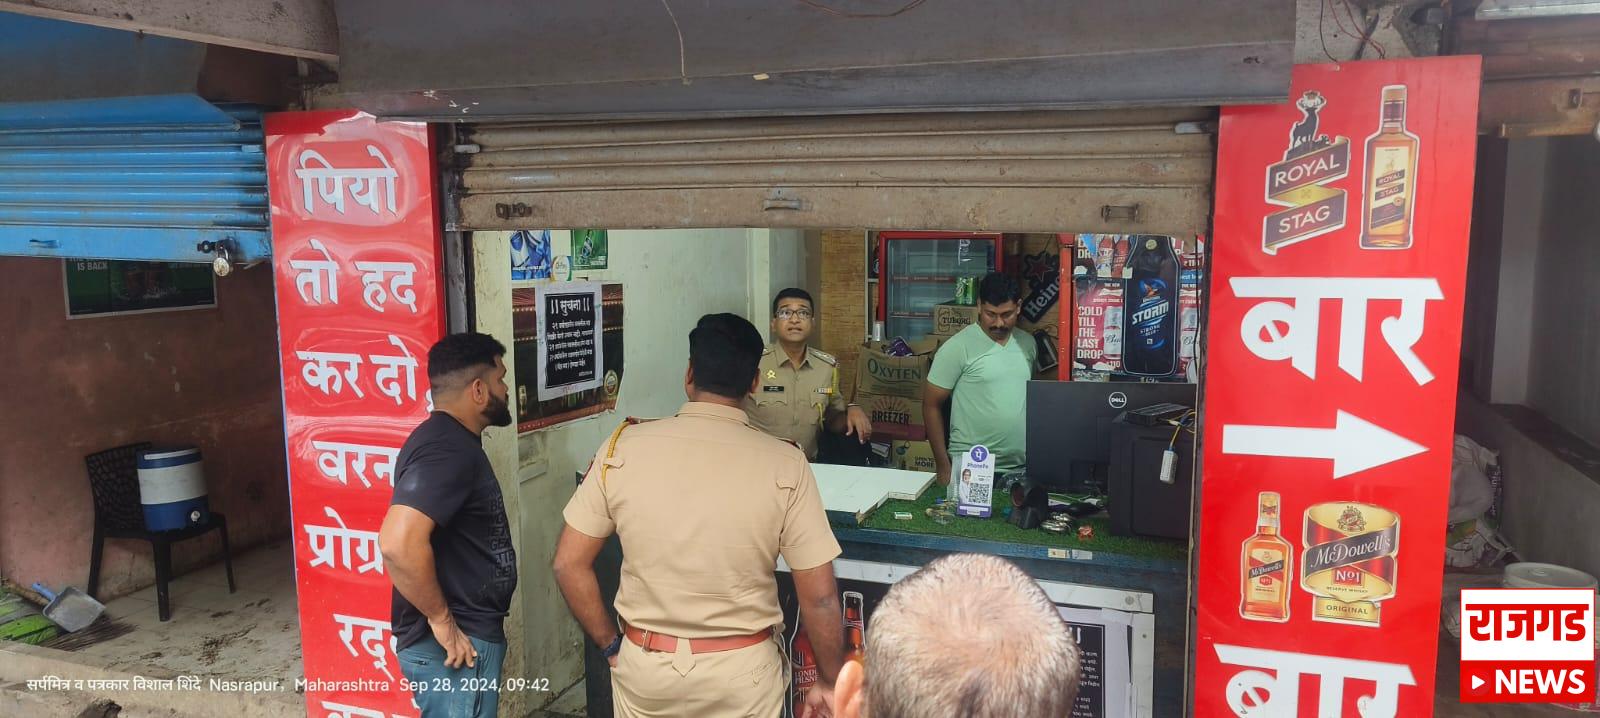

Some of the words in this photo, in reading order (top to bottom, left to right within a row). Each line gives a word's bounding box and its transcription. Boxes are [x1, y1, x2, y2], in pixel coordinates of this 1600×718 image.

[295, 144, 399, 216] पियो
[1274, 154, 1340, 188] ROYAL
[1278, 205, 1331, 235] STAG
[77, 262, 85, 271] IS
[289, 239, 338, 305] तो
[354, 261, 417, 314] हद
[1078, 305, 1103, 317] COLD
[1131, 301, 1169, 325] STORM
[1078, 316, 1097, 327] TILL
[1078, 327, 1096, 338] THE
[1228, 276, 1445, 387] बार
[1077, 338, 1100, 349] LAST
[1076, 349, 1104, 360] DROP
[295, 350, 363, 399] कर
[867, 358, 922, 380] OXYTEN
[871, 410, 910, 425] BREEZER
[1326, 604, 1368, 614] ORIGINAL
